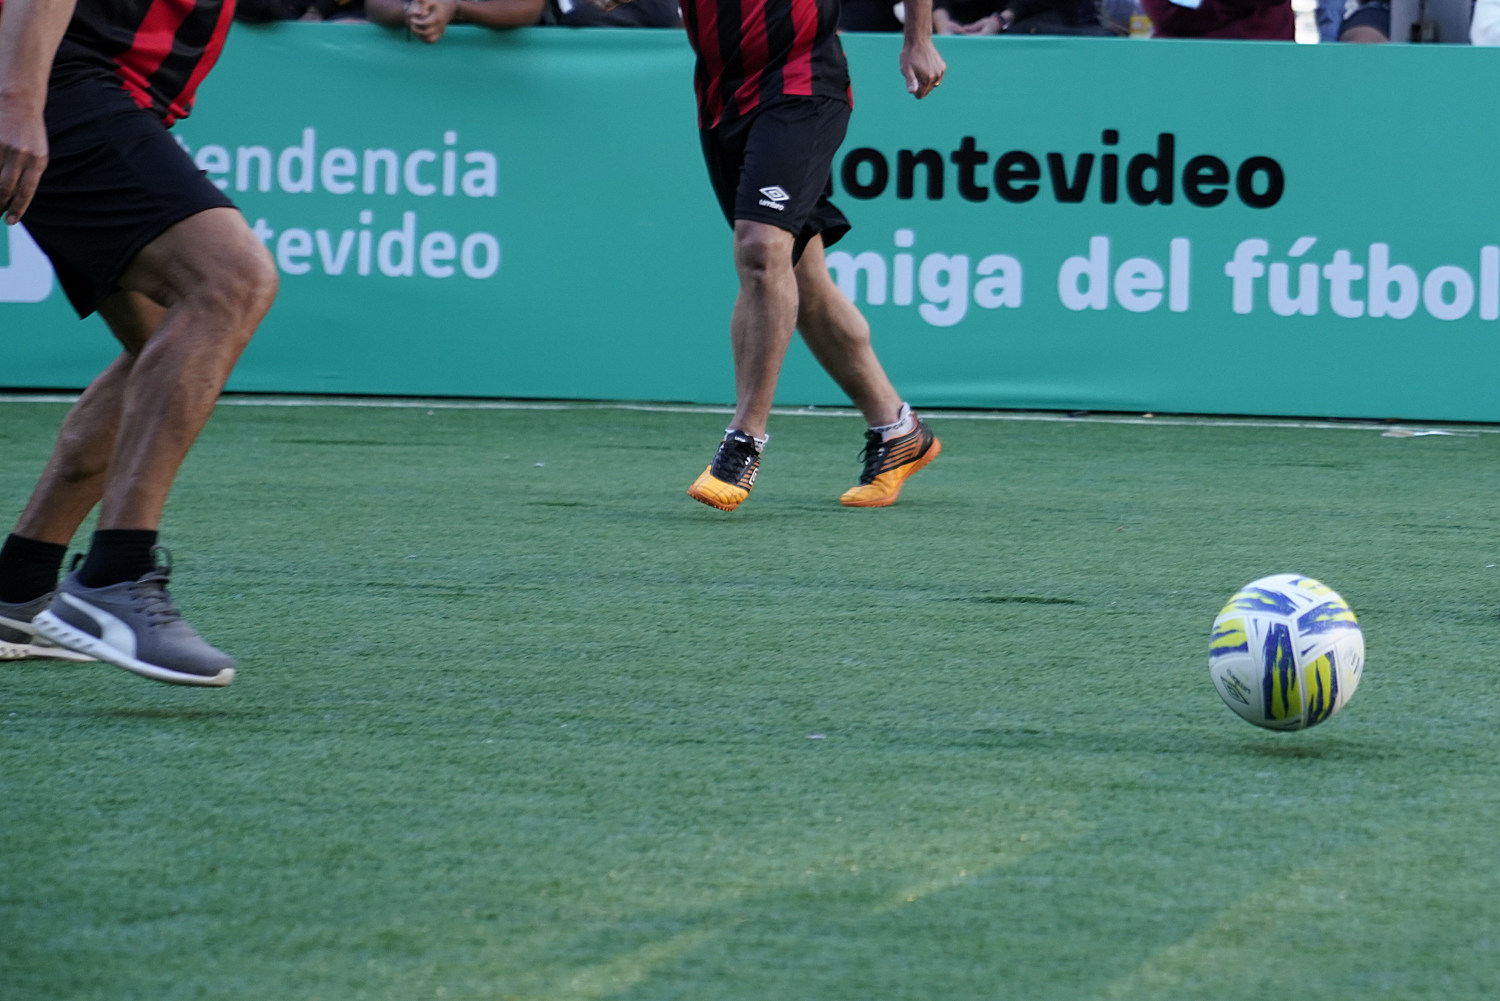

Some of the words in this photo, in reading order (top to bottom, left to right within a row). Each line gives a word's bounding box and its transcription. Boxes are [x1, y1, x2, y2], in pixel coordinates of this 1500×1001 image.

[826, 129, 1285, 209] ontevideo
[824, 228, 1023, 328] miga
[1057, 235, 1191, 313] del
[1224, 236, 1500, 321] fútbol
